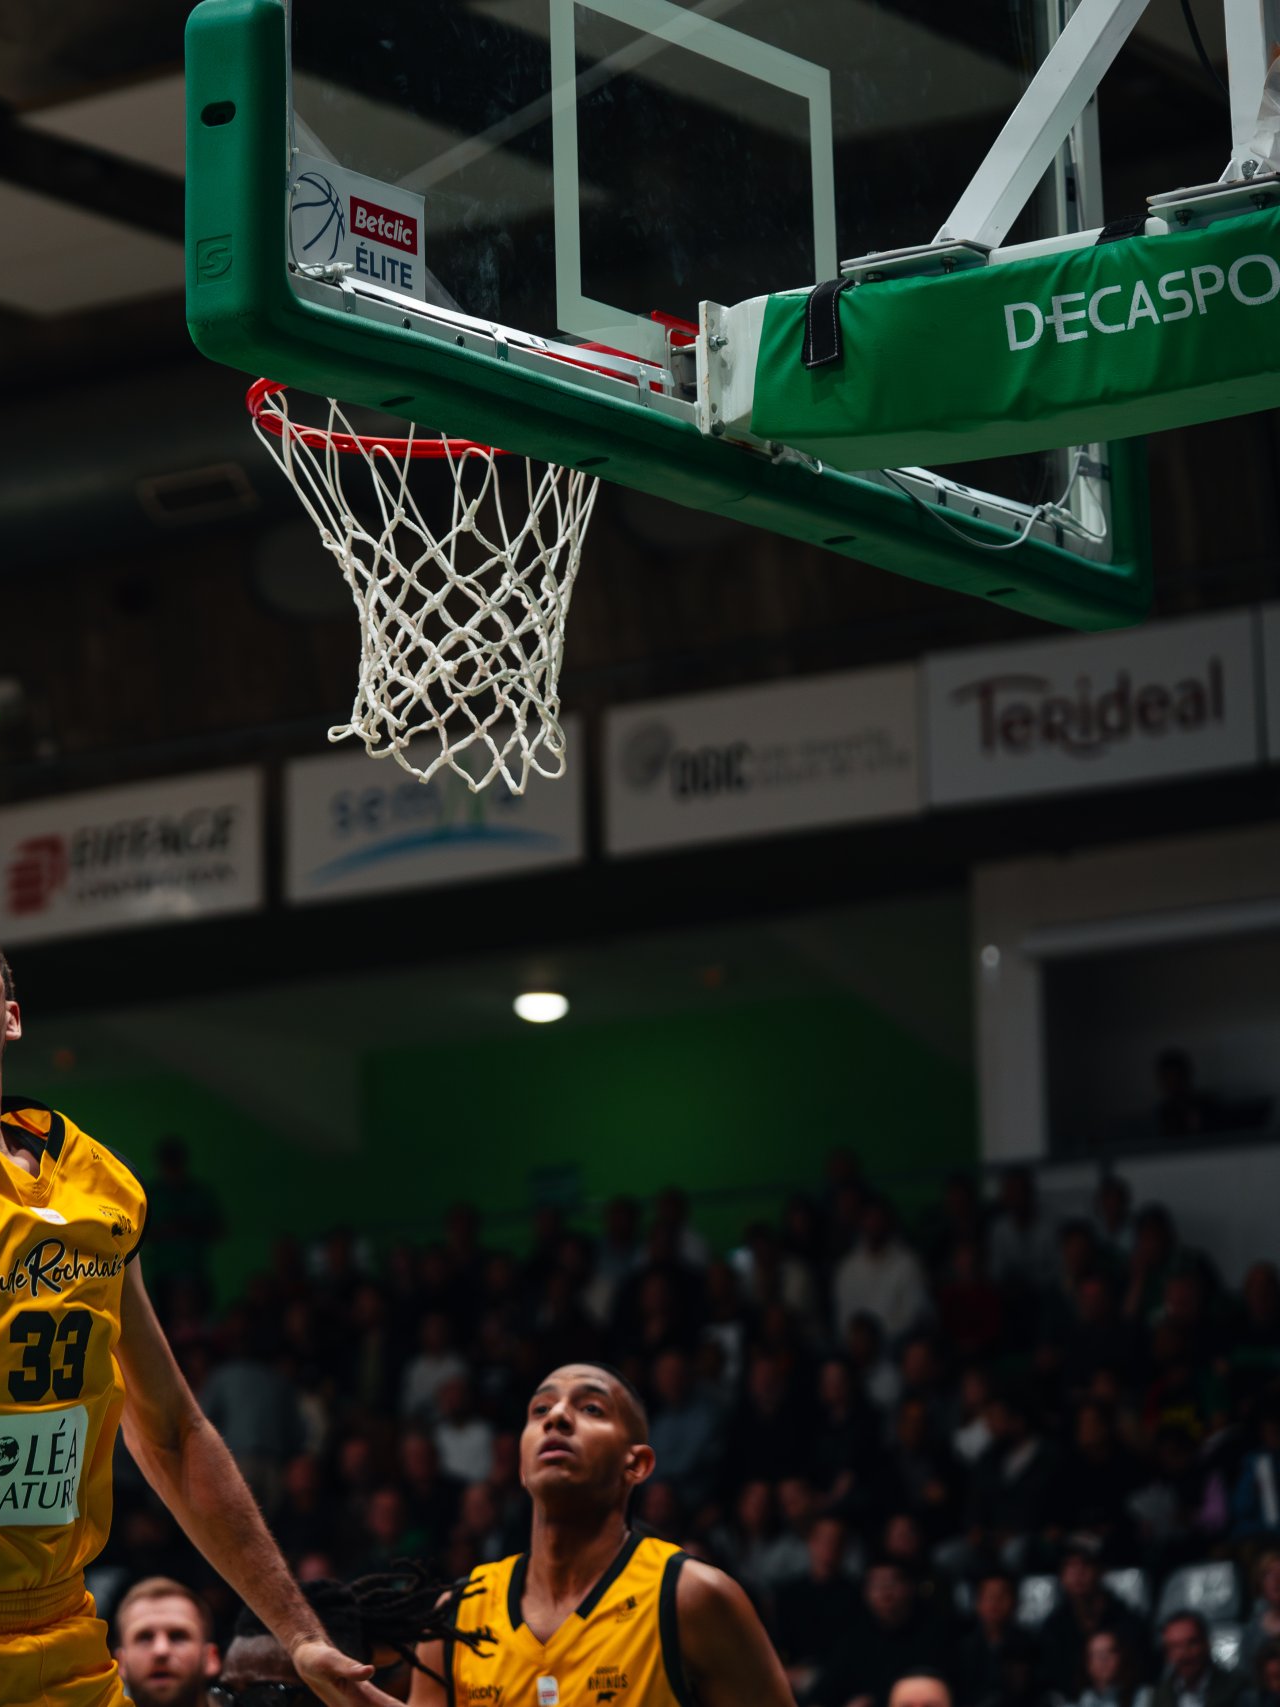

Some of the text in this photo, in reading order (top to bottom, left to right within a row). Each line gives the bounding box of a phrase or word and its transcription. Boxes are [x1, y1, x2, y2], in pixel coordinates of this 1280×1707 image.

[355, 206, 412, 245] Betclic
[355, 242, 413, 290] ÉLITE
[1004, 254, 1280, 351] DECASPO
[8, 1310, 94, 1402] 33
[24, 1418, 77, 1476] LÉA
[461, 1684, 504, 1703] icoty
